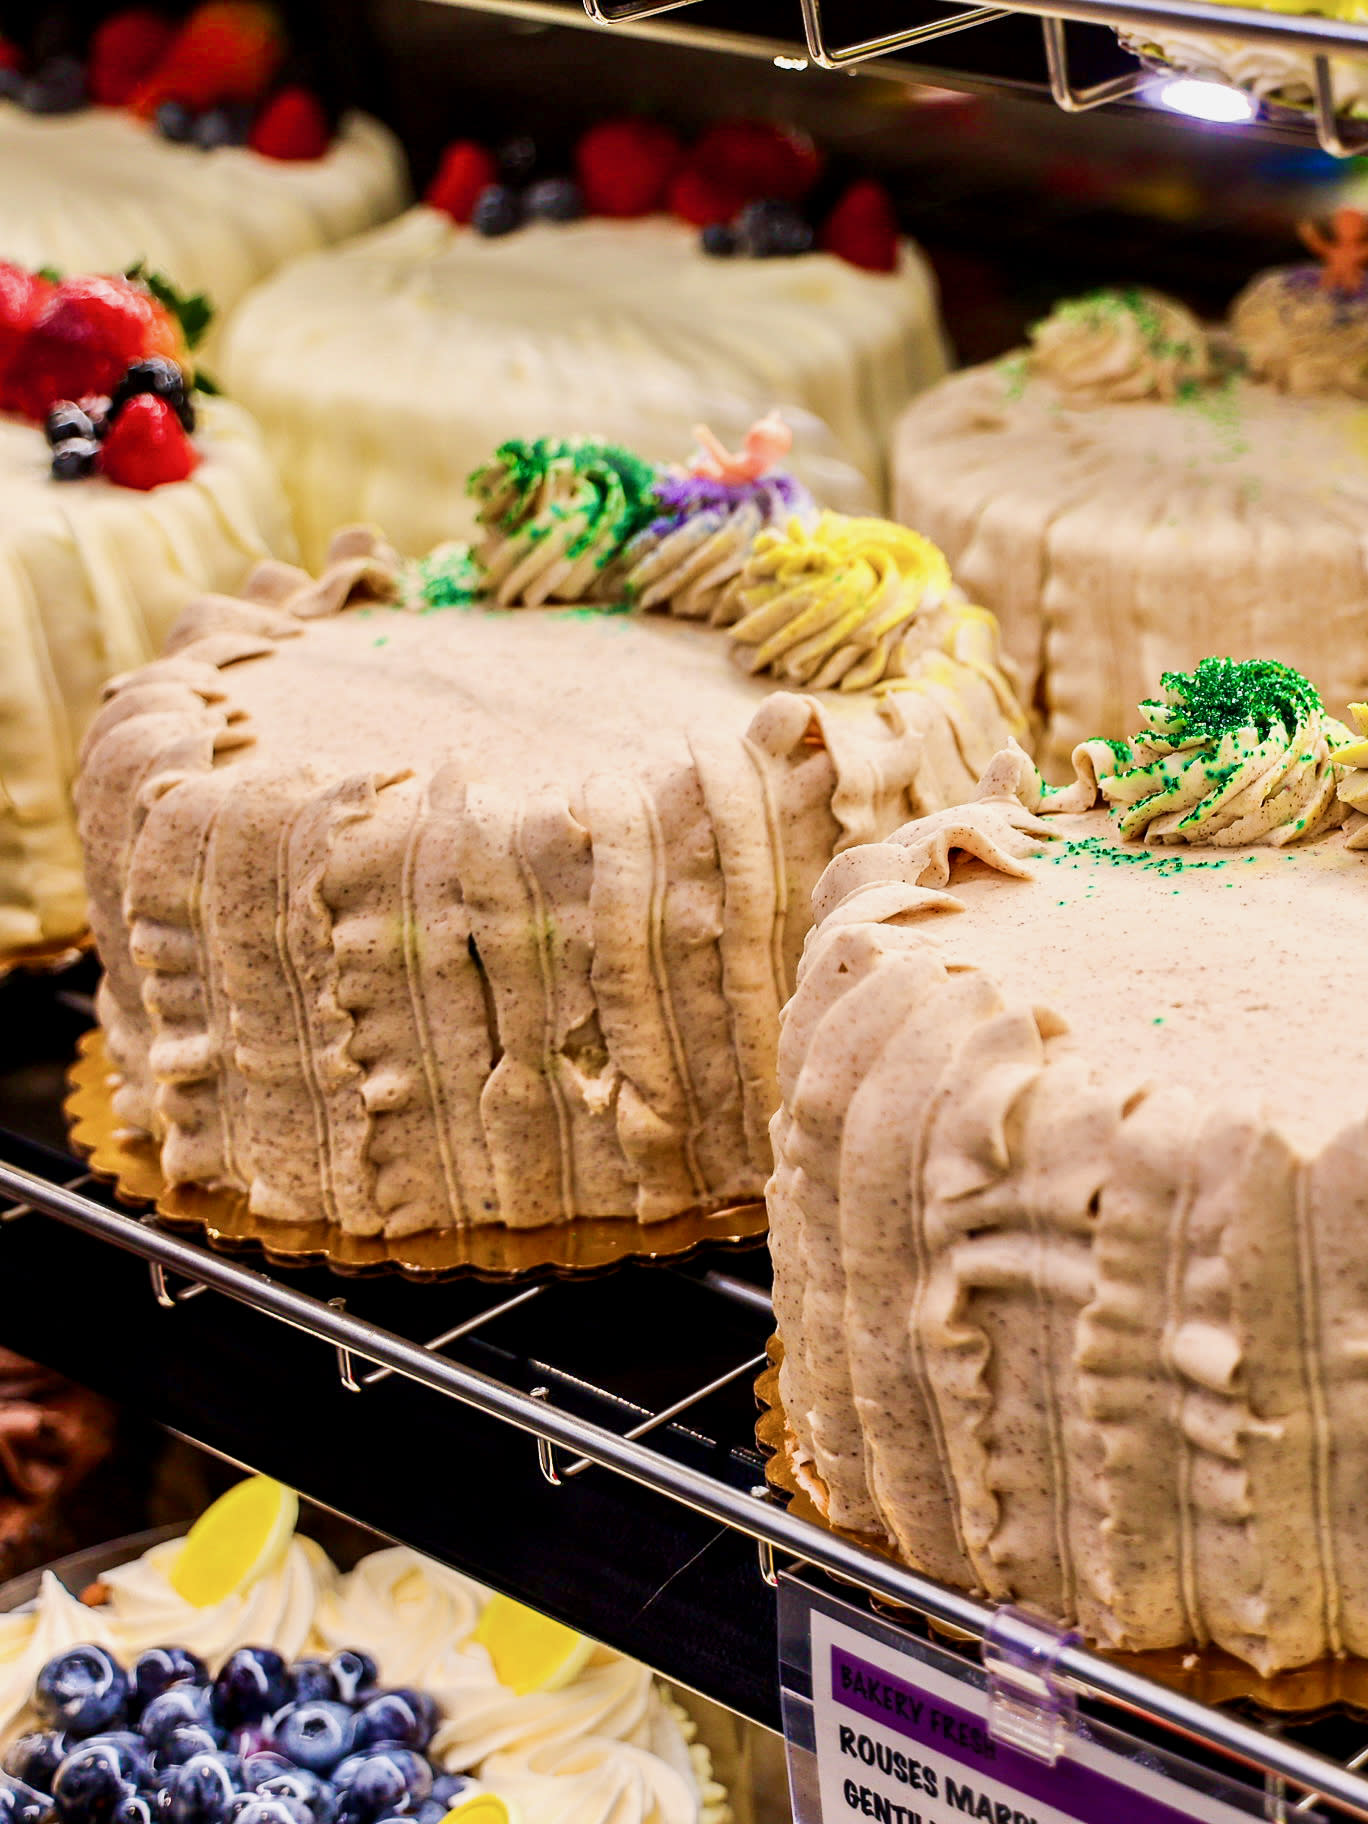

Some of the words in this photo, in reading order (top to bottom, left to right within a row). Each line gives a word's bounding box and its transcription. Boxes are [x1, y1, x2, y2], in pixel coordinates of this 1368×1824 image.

[841, 1663, 925, 1725] BAKERY
[929, 1708, 998, 1760] FRESH
[839, 1724, 938, 1798] ROUSES
[945, 1776, 1038, 1824] MAR
[843, 1778, 937, 1824] GENTI
